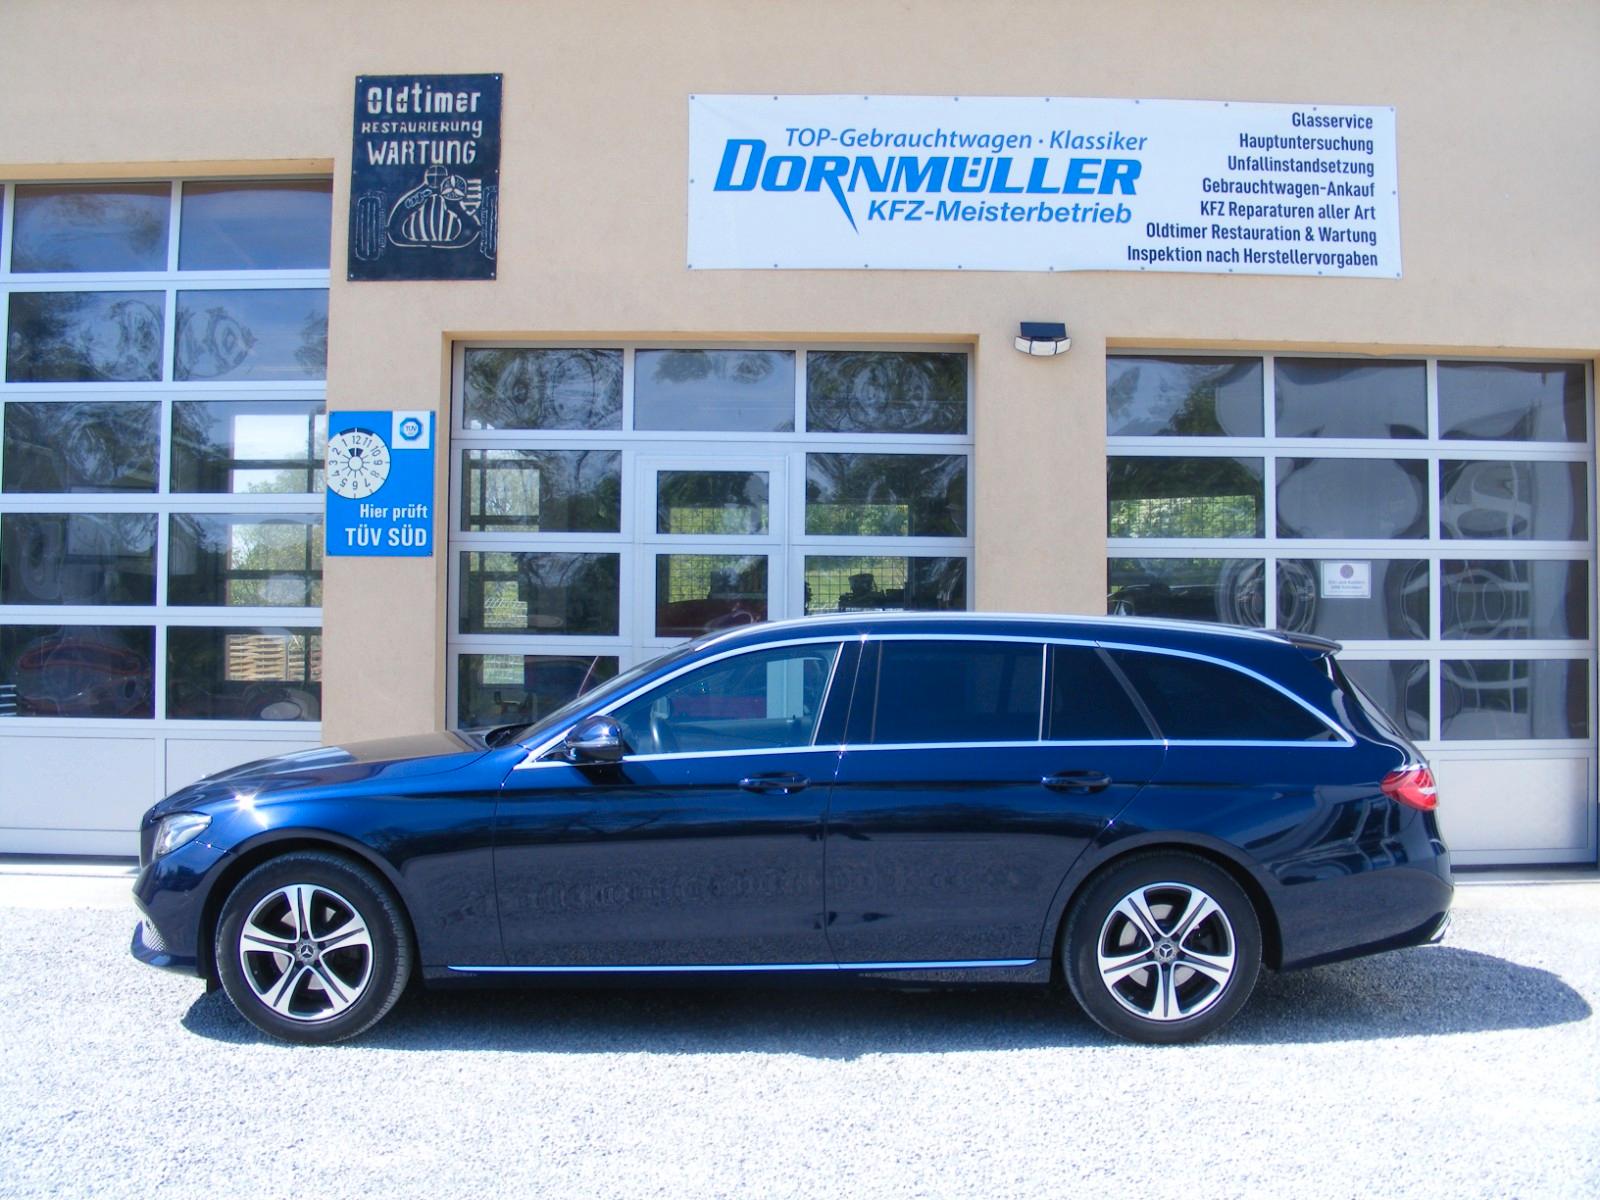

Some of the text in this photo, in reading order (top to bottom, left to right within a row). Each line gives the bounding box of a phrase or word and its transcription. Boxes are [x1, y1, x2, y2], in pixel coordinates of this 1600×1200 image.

[367, 82, 481, 114] Oldtimer
[1292, 112, 1373, 129] Glasservice
[785, 127, 1148, 153] TOP-Gebrauchtwagen Klassiker
[1240, 133, 1373, 154] Hauptuntersuchung
[1228, 156, 1375, 177] Unfallinstandsetzung
[1202, 178, 1375, 198] Gebrauchtwagen-Ankauf
[867, 199, 1131, 224] KFZ-Meisterbetrieb
[1200, 201, 1376, 220] KFZ Reparaturen aller Art
[1146, 222, 1377, 246] Oldtimer Restauration & Wartung
[1128, 246, 1378, 268] Inspektion nach Herstellervorgaben
[352, 436, 361, 444] 12
[363, 437, 372, 446] 11
[332, 447, 341, 455] 2
[371, 445, 381, 456] 10
[340, 478, 348, 487] 5
[353, 481, 358, 490] 6
[360, 504, 428, 521] Hier prüft
[345, 524, 427, 546] TÜV SÜD
